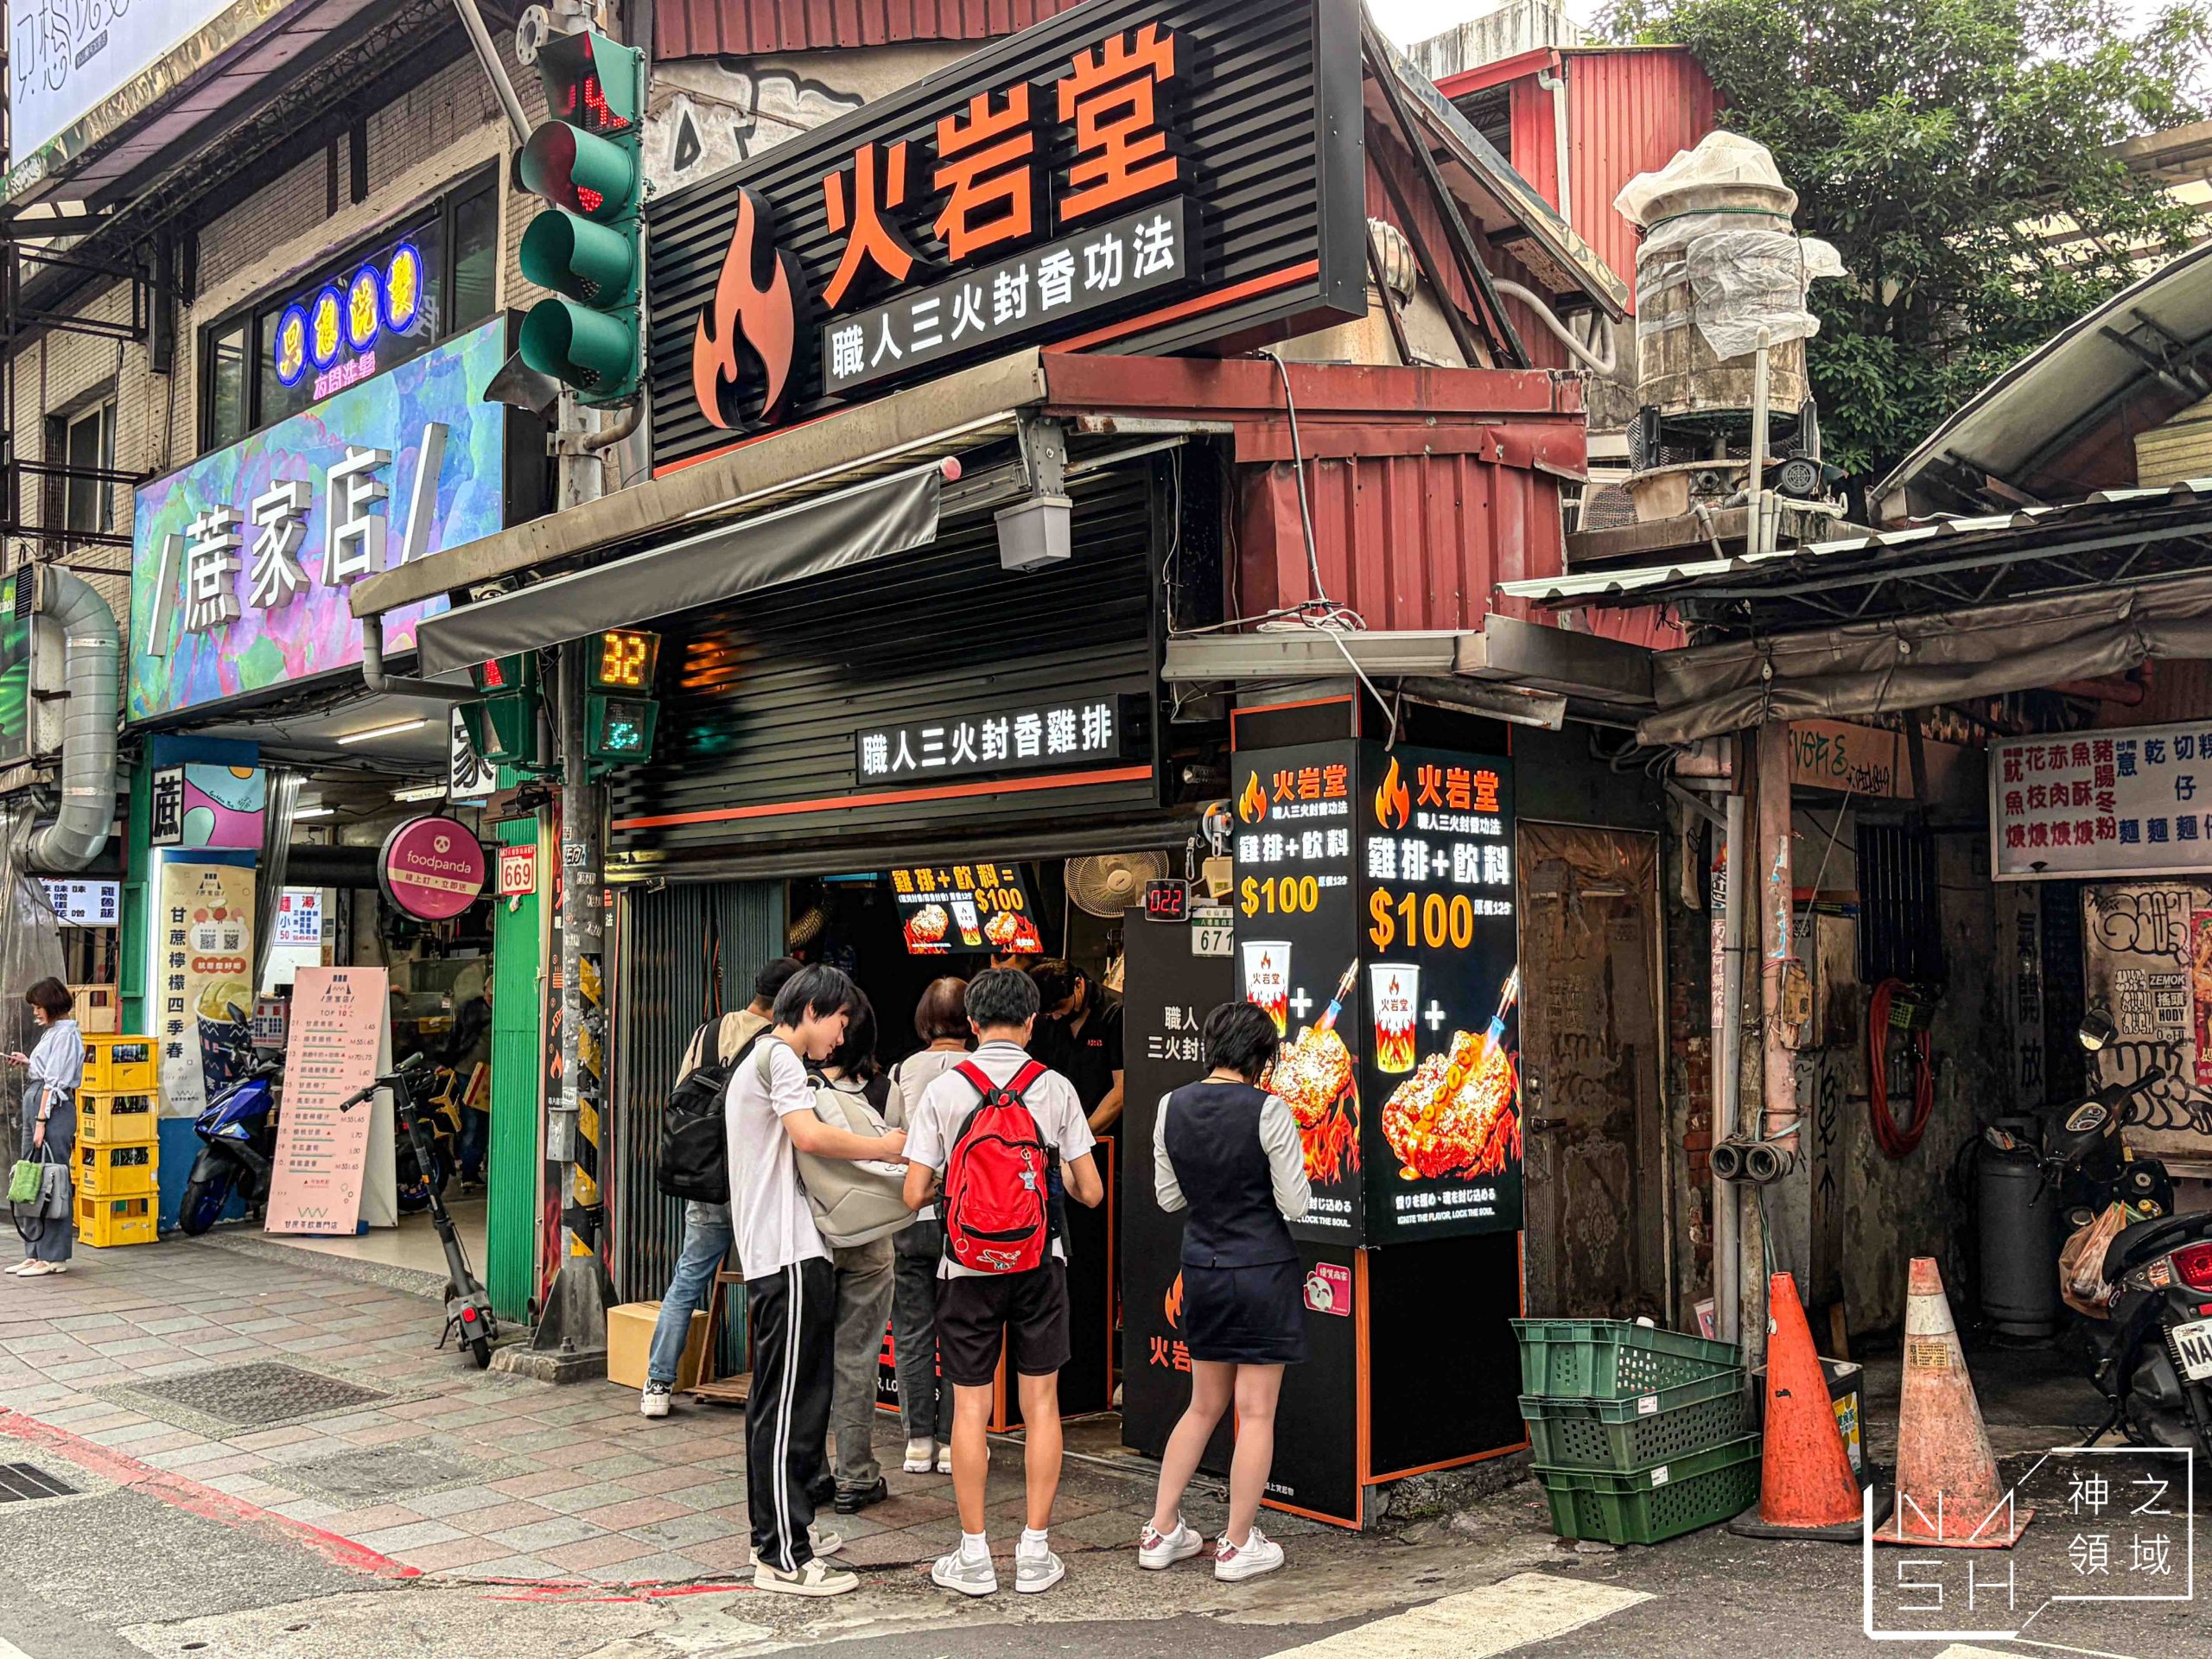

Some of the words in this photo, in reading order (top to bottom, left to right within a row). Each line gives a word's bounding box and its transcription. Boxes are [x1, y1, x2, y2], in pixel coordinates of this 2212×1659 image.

[822, 22, 1178, 309] 火岩堂
[832, 214, 1175, 378] 職人三火封香功法
[600, 634, 645, 684] 32
[862, 703, 1113, 775] 職人三火封香雞排
[1272, 764, 1348, 803] 火岩堂
[1416, 764, 1500, 812] 火岩堂
[154, 776, 181, 837] 蔗
[407, 849, 472, 874] foodpanda
[505, 861, 531, 887] 669
[974, 887, 1024, 914] $100
[1149, 889, 1183, 912] 022
[1240, 875, 1319, 918] $100
[1369, 887, 1473, 953] $100
[1200, 929, 1234, 952] 671
[166, 906, 188, 1059] 甘蔗檸檬四季春
[1253, 972, 1281, 985] 火岩堂
[2150, 975, 2185, 986] ZEMOK
[1381, 998, 1408, 1012] 火岩堂
[1165, 1006, 1199, 1032] 職人
[1147, 1035, 1205, 1063] 三火封
[1301, 1215, 1319, 1224] LOCK
[1319, 1217, 1332, 1226] THE
[1452, 1209, 1468, 1218] LOCK
[1468, 1208, 1478, 1217] THE
